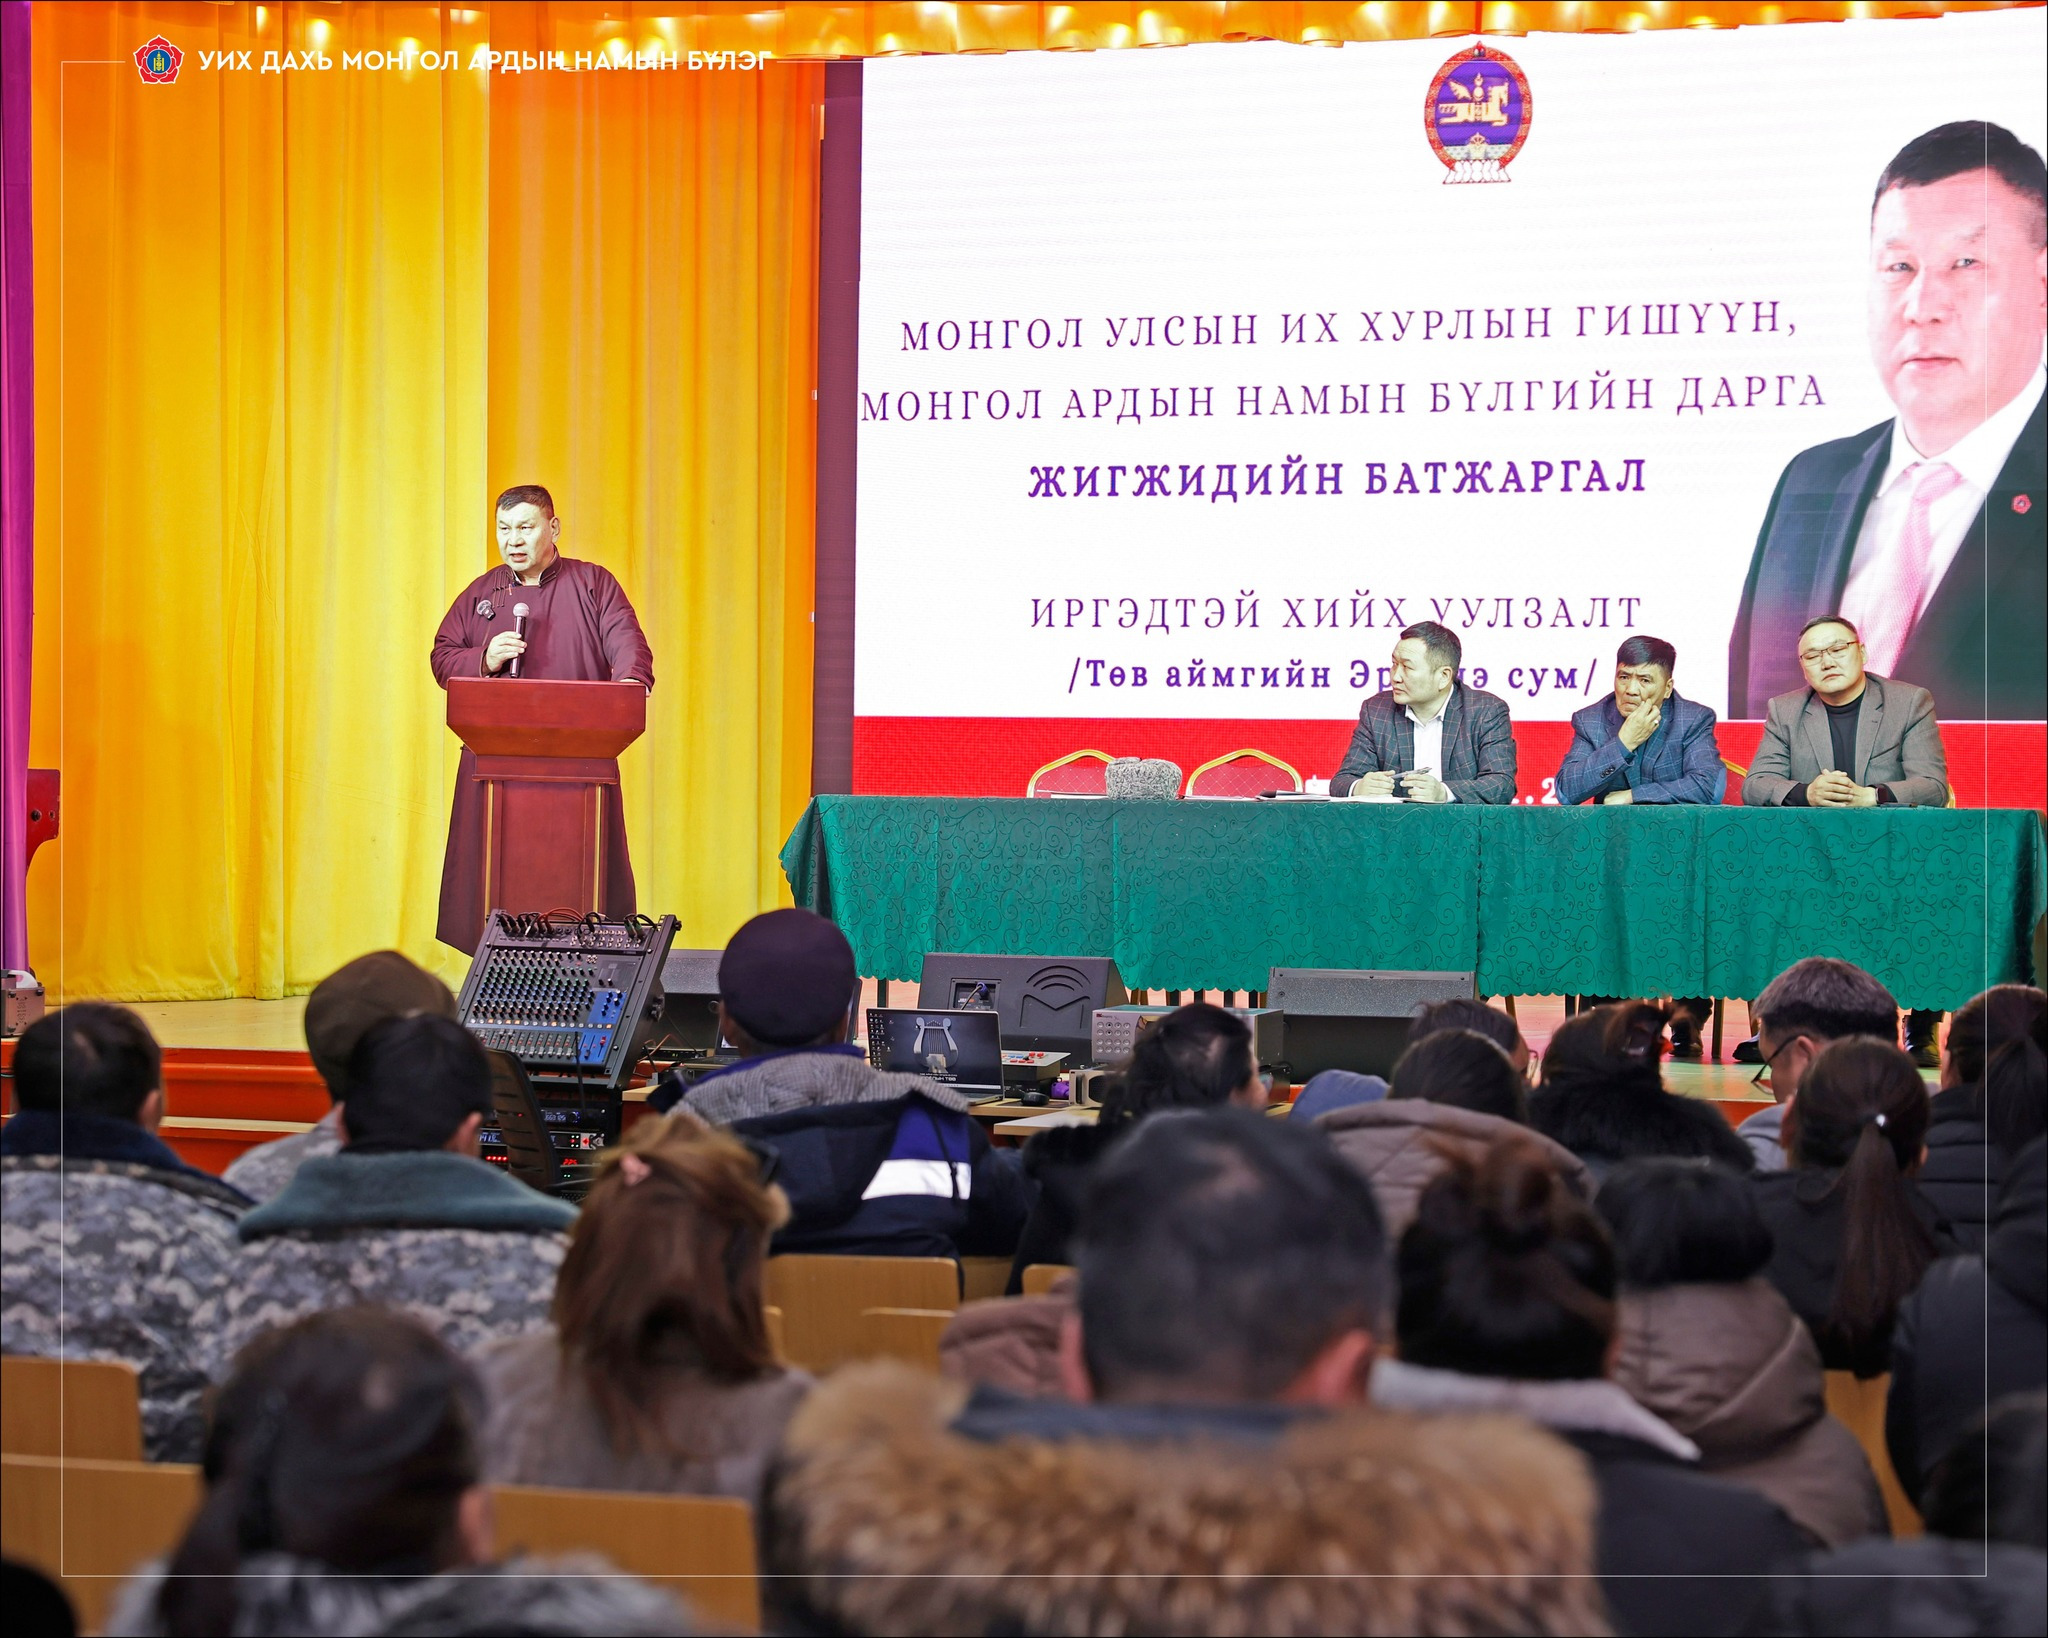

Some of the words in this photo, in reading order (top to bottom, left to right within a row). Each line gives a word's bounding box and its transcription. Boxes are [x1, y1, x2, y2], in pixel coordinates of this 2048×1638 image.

[901, 318, 1083, 351] МОНГОЛ
[1105, 314, 1258, 348] УЛСЫН
[1281, 312, 1339, 344] ИХ
[1359, 307, 1552, 342] ХУРЛЫН
[1576, 300, 1796, 338] ГИШҮҮН,
[861, 389, 1042, 422] МОНГОЛ
[1062, 386, 1214, 425] АРДЫН
[1236, 383, 1406, 417] НАМЫН
[1429, 369, 1654, 414] БҮЛГИЙН
[1676, 374, 1826, 416] ДАРГА
[1027, 455, 1344, 503] ЖИГЖИДИЙН
[1364, 458, 1646, 495] БАТЖАРГАЛ
[1031, 589, 1260, 635] ИРГЭДТЭЙ
[1282, 588, 1408, 629] ХИЙХ
[1429, 597, 1641, 629] УУЛЗАЛТ
[1068, 657, 1148, 694] /Төв
[1165, 659, 1331, 688] аймгийн
[1508, 658, 1598, 698] сум/
